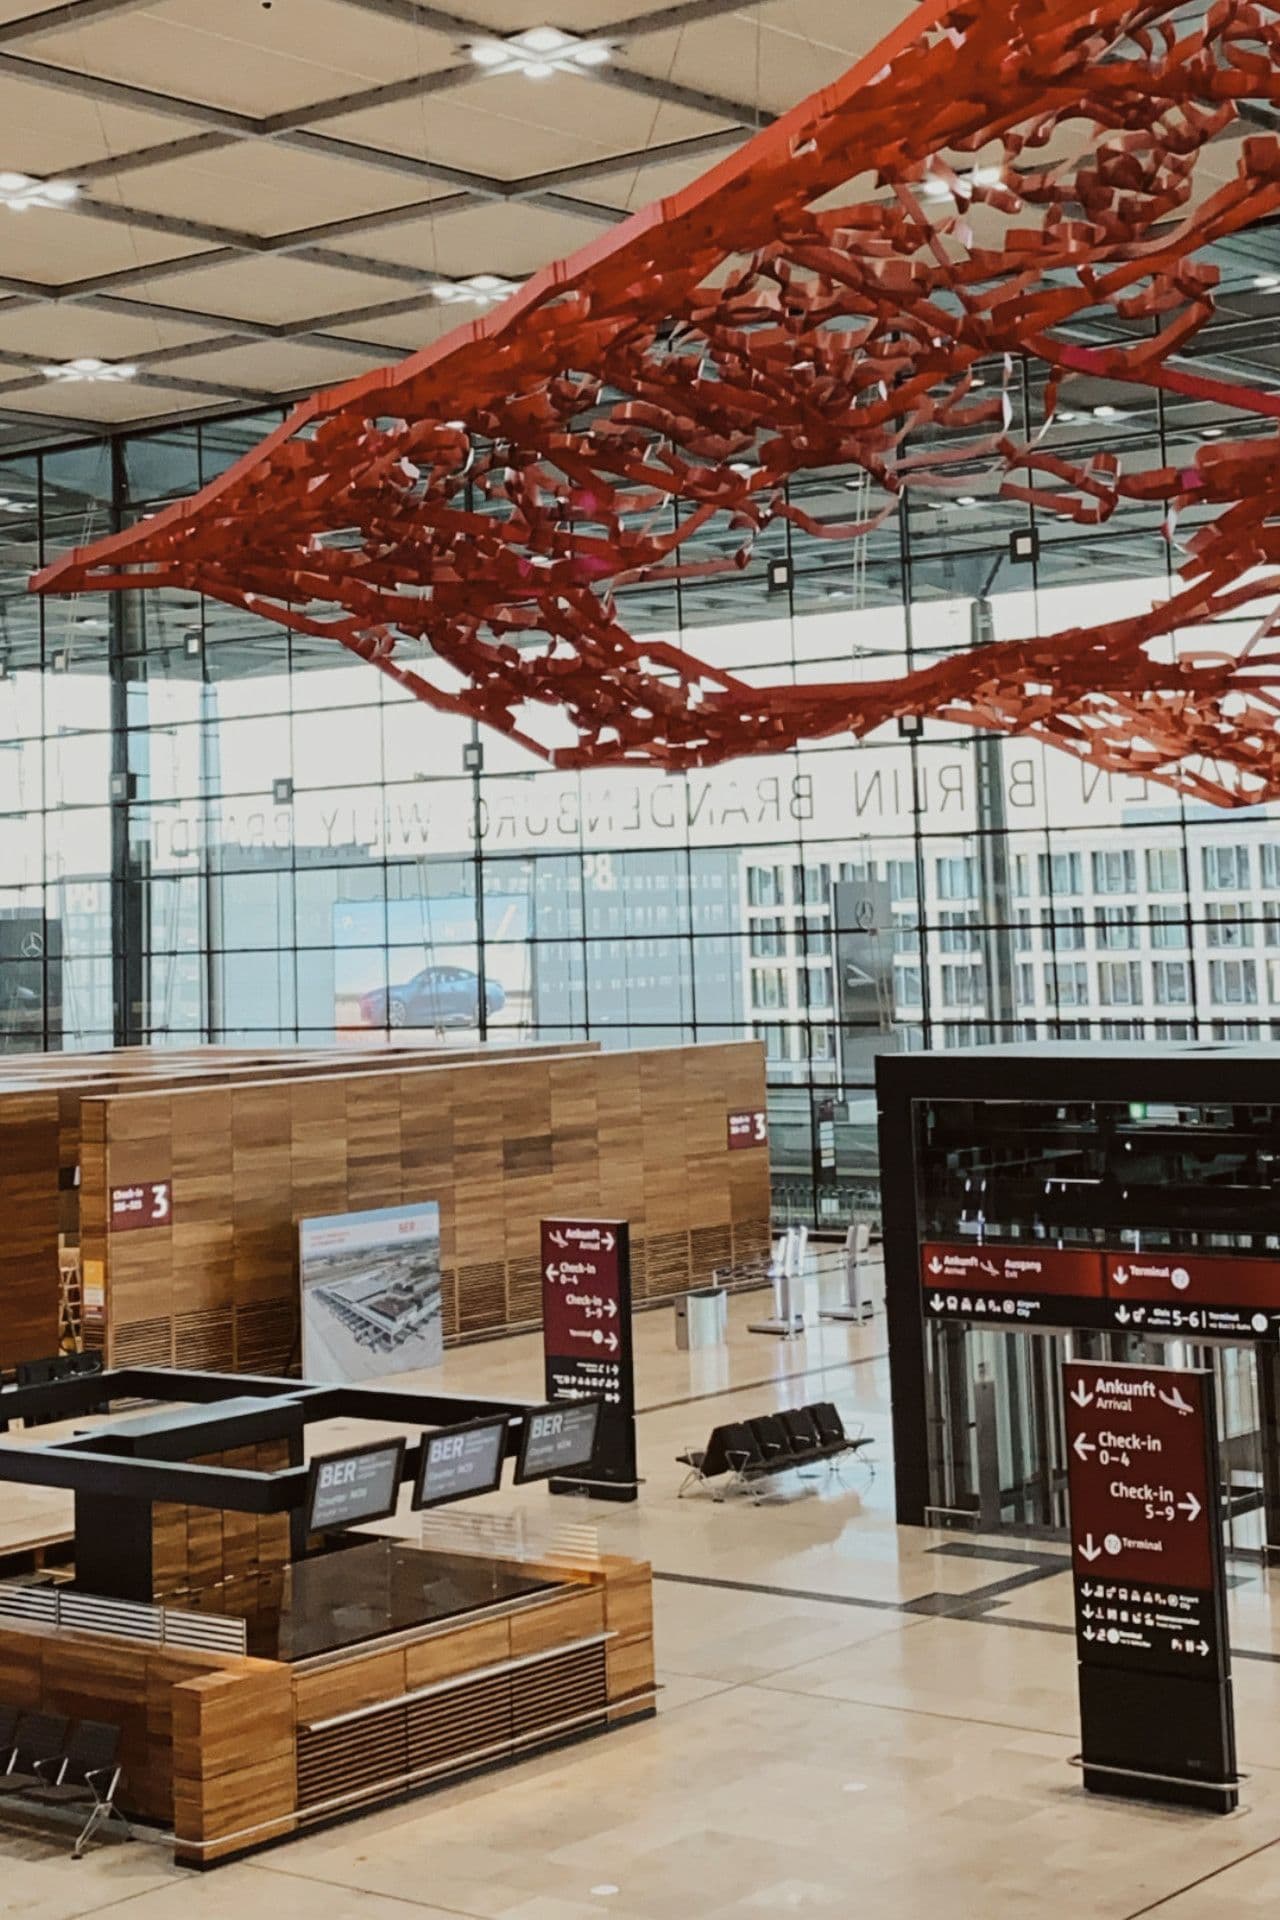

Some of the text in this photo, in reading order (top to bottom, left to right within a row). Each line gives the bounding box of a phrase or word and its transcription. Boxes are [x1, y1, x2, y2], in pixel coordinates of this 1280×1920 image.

[151, 1184, 169, 1219] 3
[1004, 1258, 1042, 1273] Ausgang
[1128, 1264, 1170, 1278] Terminal
[1095, 1377, 1157, 1398] Ankunft
[1096, 1396, 1132, 1412] Arrival
[531, 1413, 563, 1440] BER
[431, 1437, 464, 1464] BER
[1098, 1431, 1162, 1452] Check-in
[320, 1460, 357, 1489] BER
[1109, 1481, 1174, 1502] Check-in
[1122, 1537, 1163, 1552] Terminal
